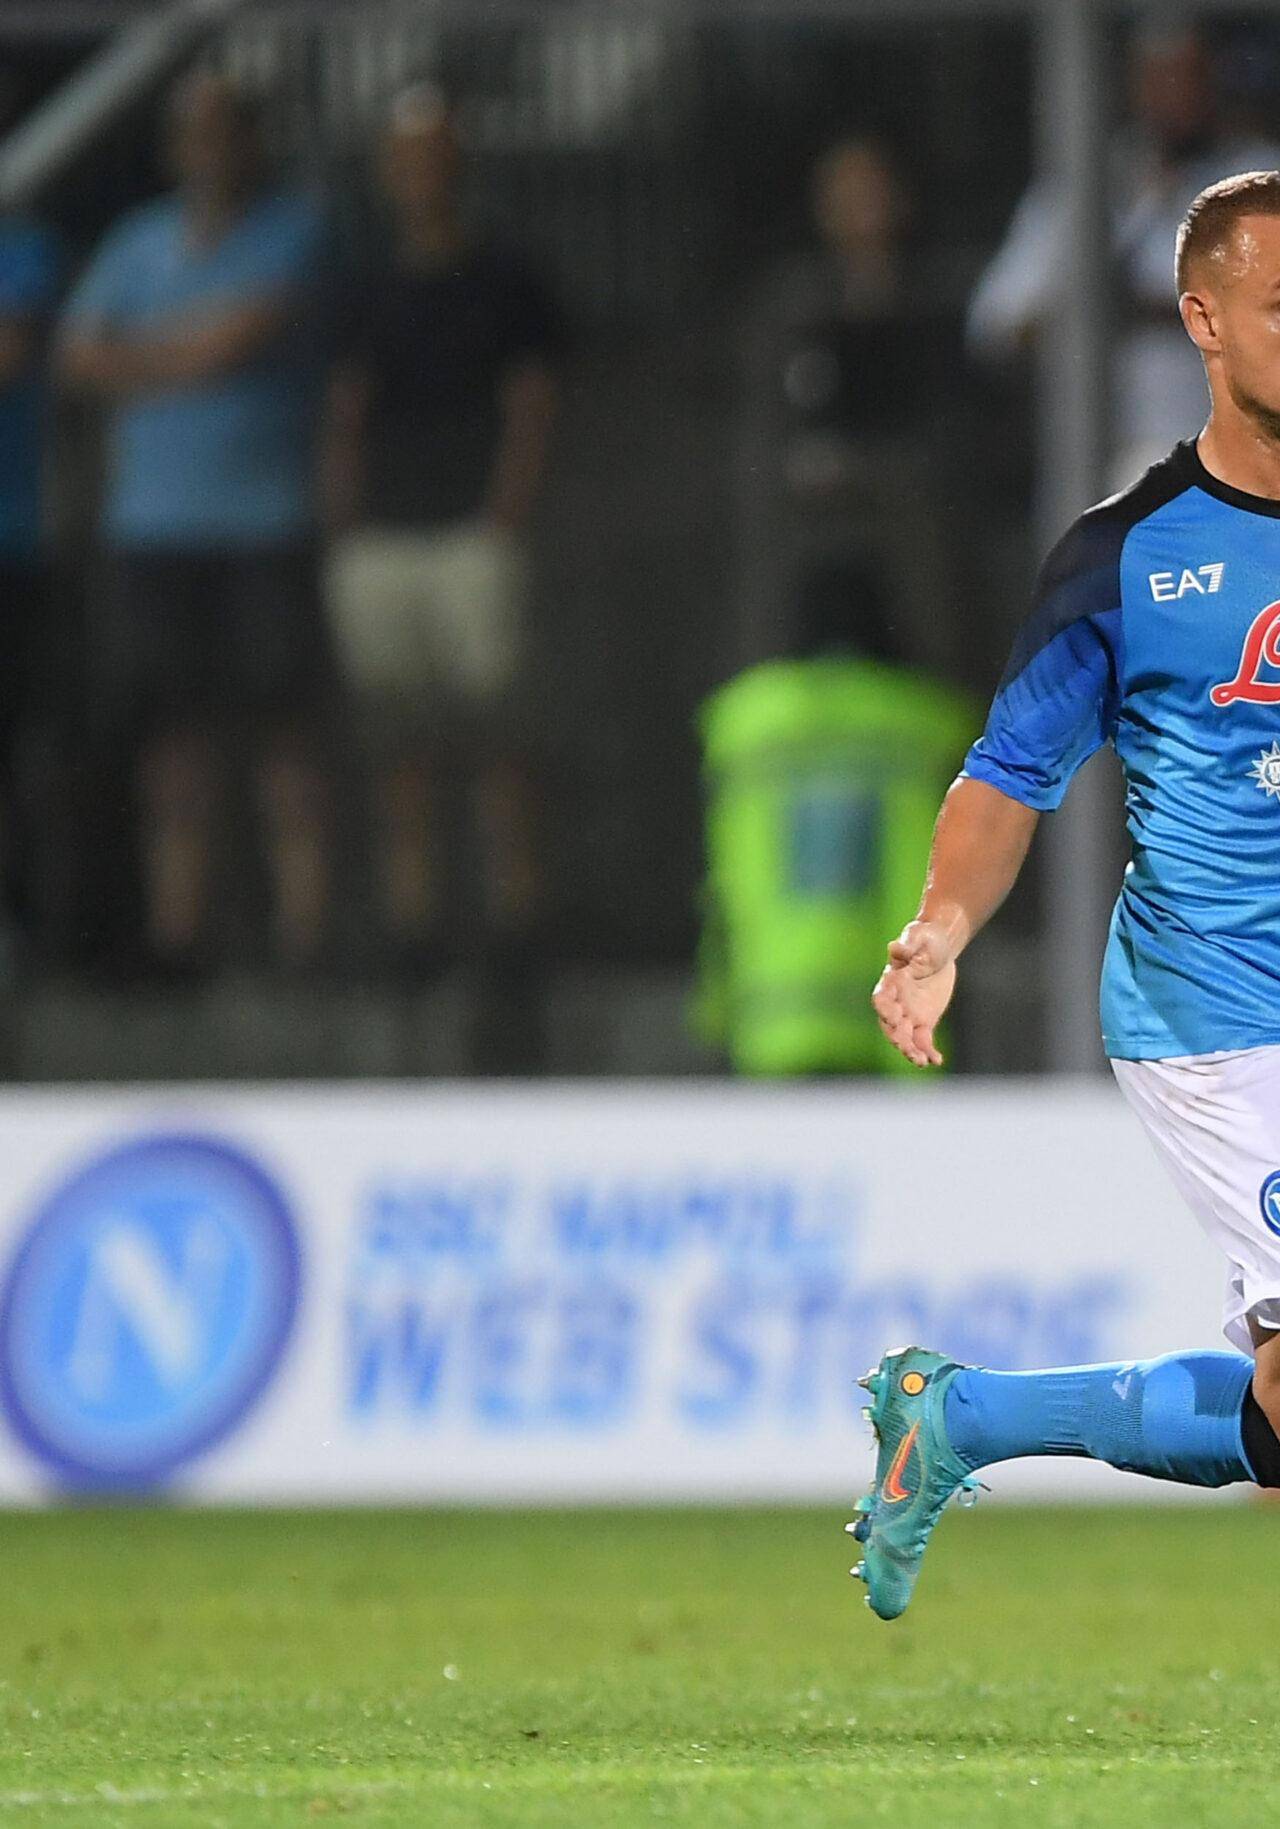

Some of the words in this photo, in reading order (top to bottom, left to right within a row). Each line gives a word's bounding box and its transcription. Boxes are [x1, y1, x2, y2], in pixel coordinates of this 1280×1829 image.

[1149, 562, 1225, 602] EA7
[68, 1213, 226, 1402] N
[344, 1268, 642, 1428] WEB
